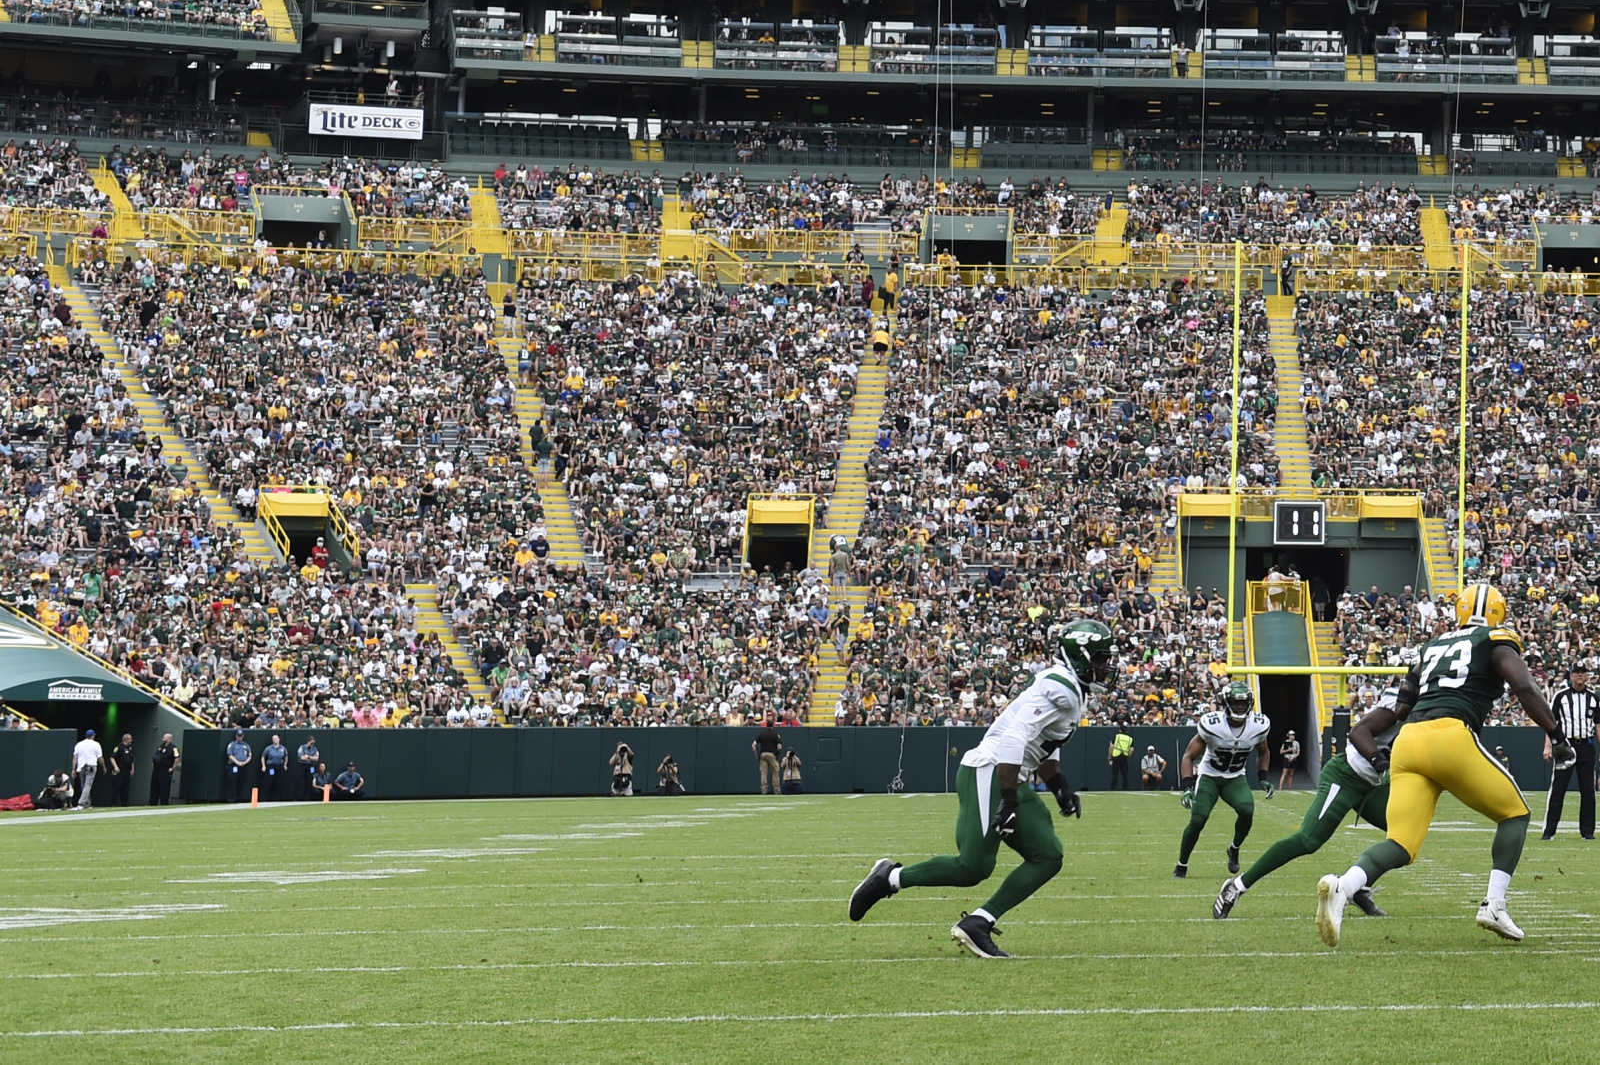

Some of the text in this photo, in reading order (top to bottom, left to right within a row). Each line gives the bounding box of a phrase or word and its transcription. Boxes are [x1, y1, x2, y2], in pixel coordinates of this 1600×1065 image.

[322, 111, 402, 133] Lite DECK
[821, 470, 830, 478] 92
[1292, 510, 1320, 536] 11
[1419, 639, 1472, 695] 73
[478, 712, 487, 720] 12
[1210, 749, 1250, 773] 35
